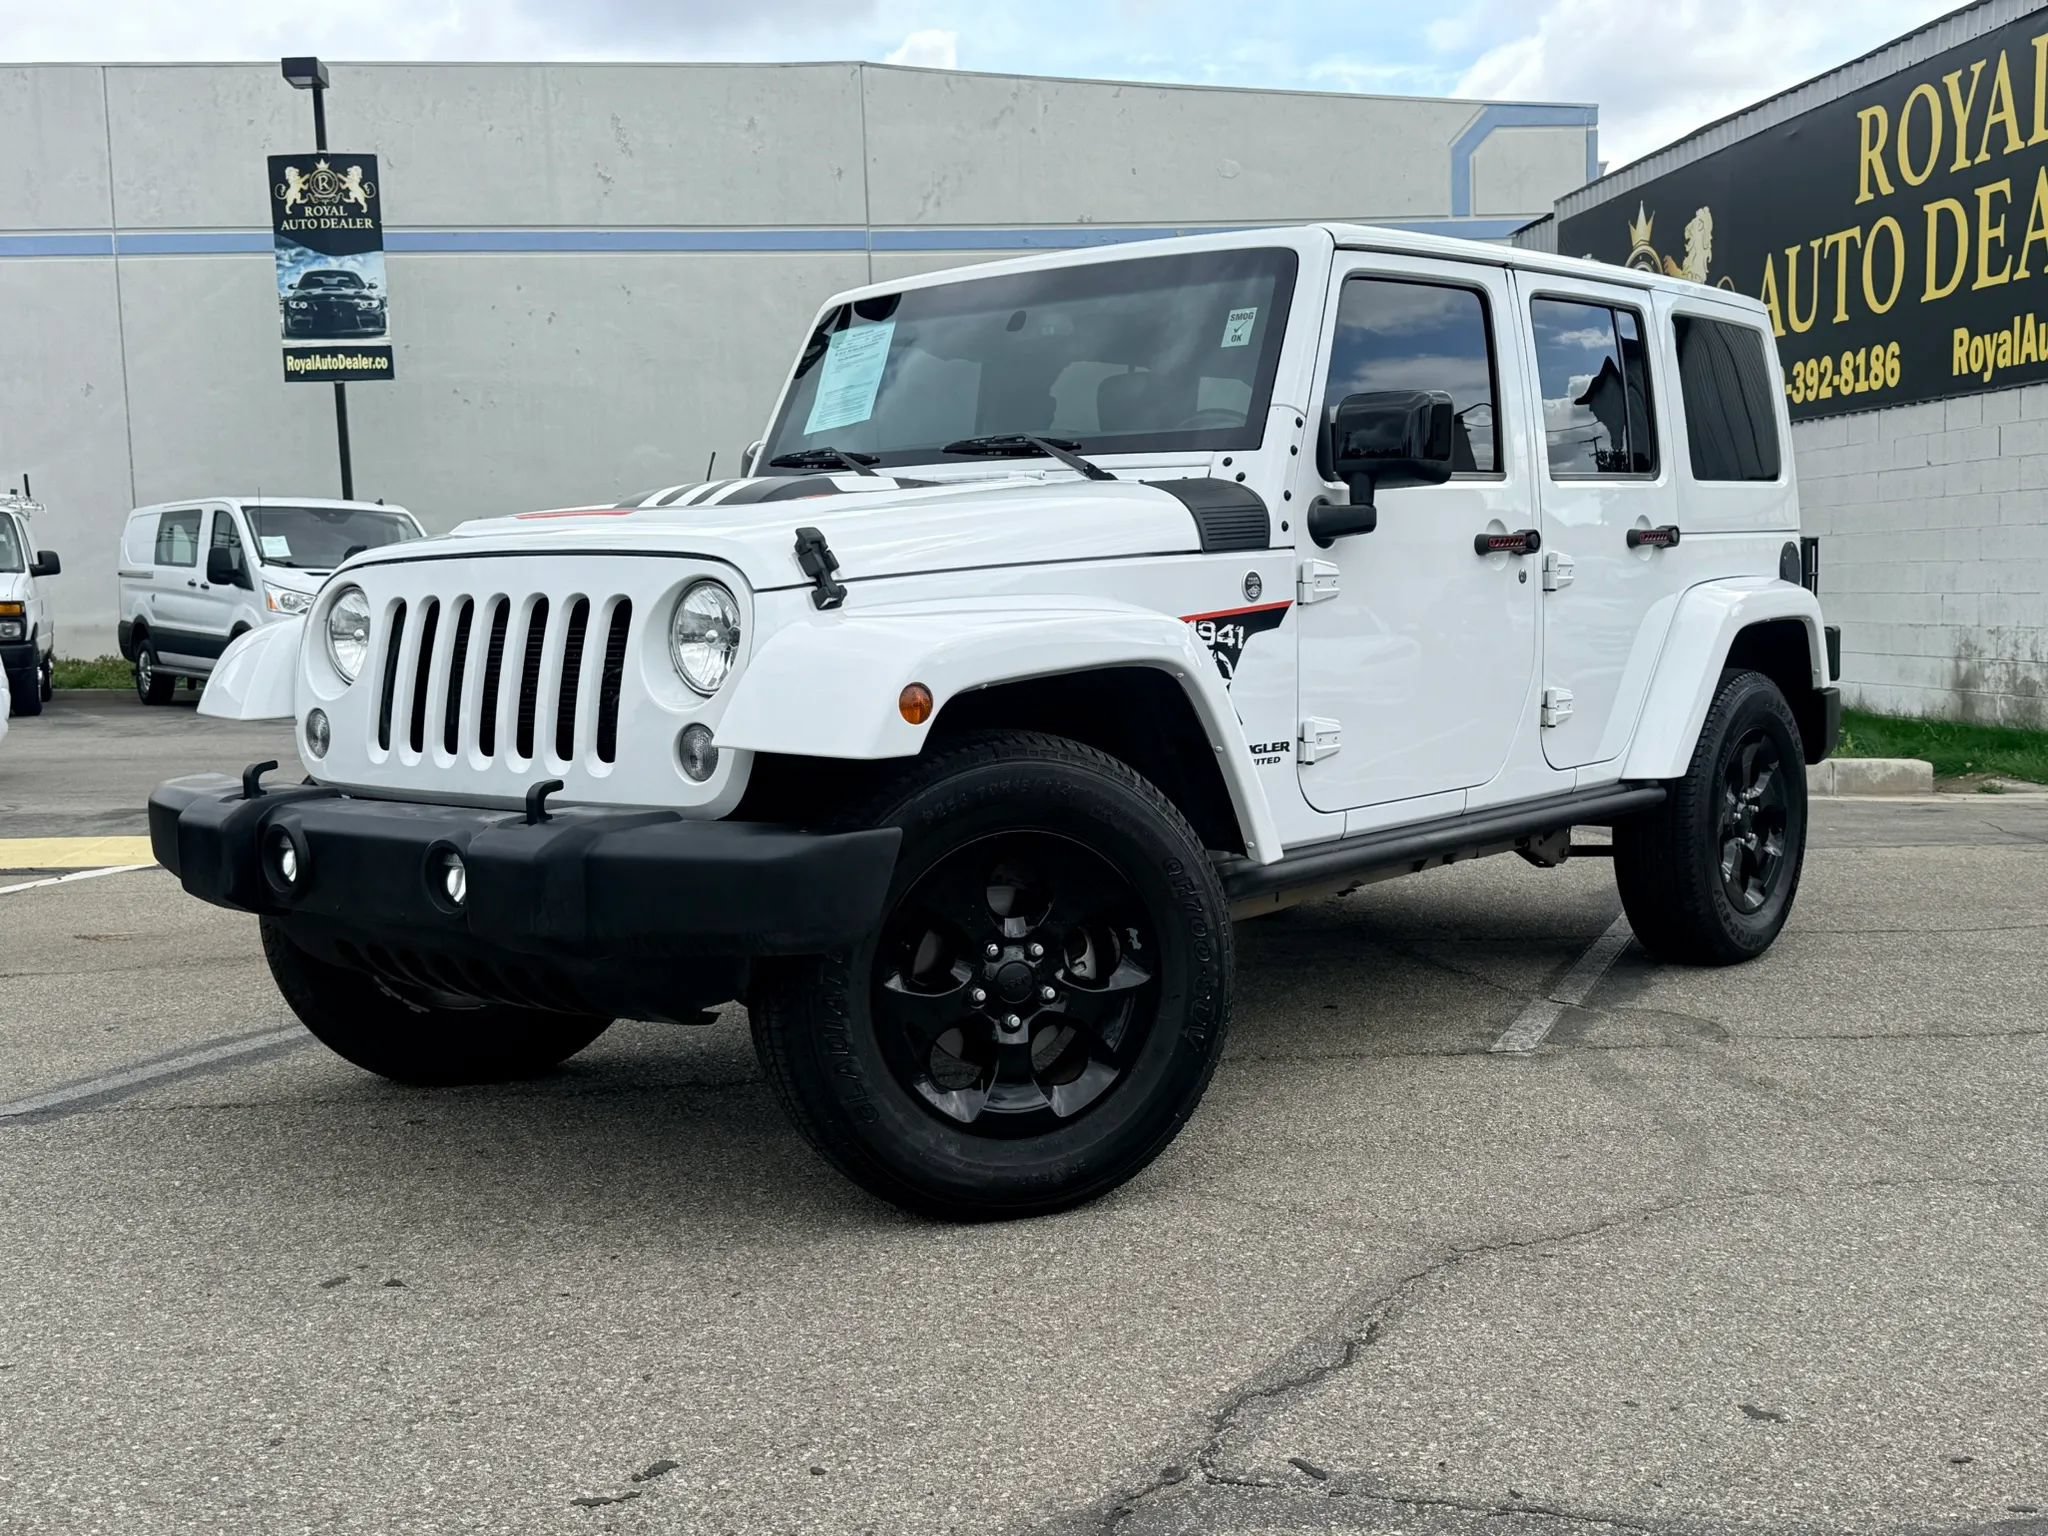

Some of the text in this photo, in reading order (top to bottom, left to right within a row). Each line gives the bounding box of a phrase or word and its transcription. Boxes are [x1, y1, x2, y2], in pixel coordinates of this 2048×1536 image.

[318, 174, 329, 190] R
[304, 205, 348, 217] ROYAL
[281, 218, 374, 230] AUTO DEALER
[1760, 216, 1905, 338] AUTO
[1230, 311, 1254, 321] SMOG
[1231, 333, 1243, 343] OK
[286, 354, 389, 374] RoyalAutoDealer.co
[1781, 341, 1901, 404] -392-8186
[1254, 756, 1281, 766] ITED
